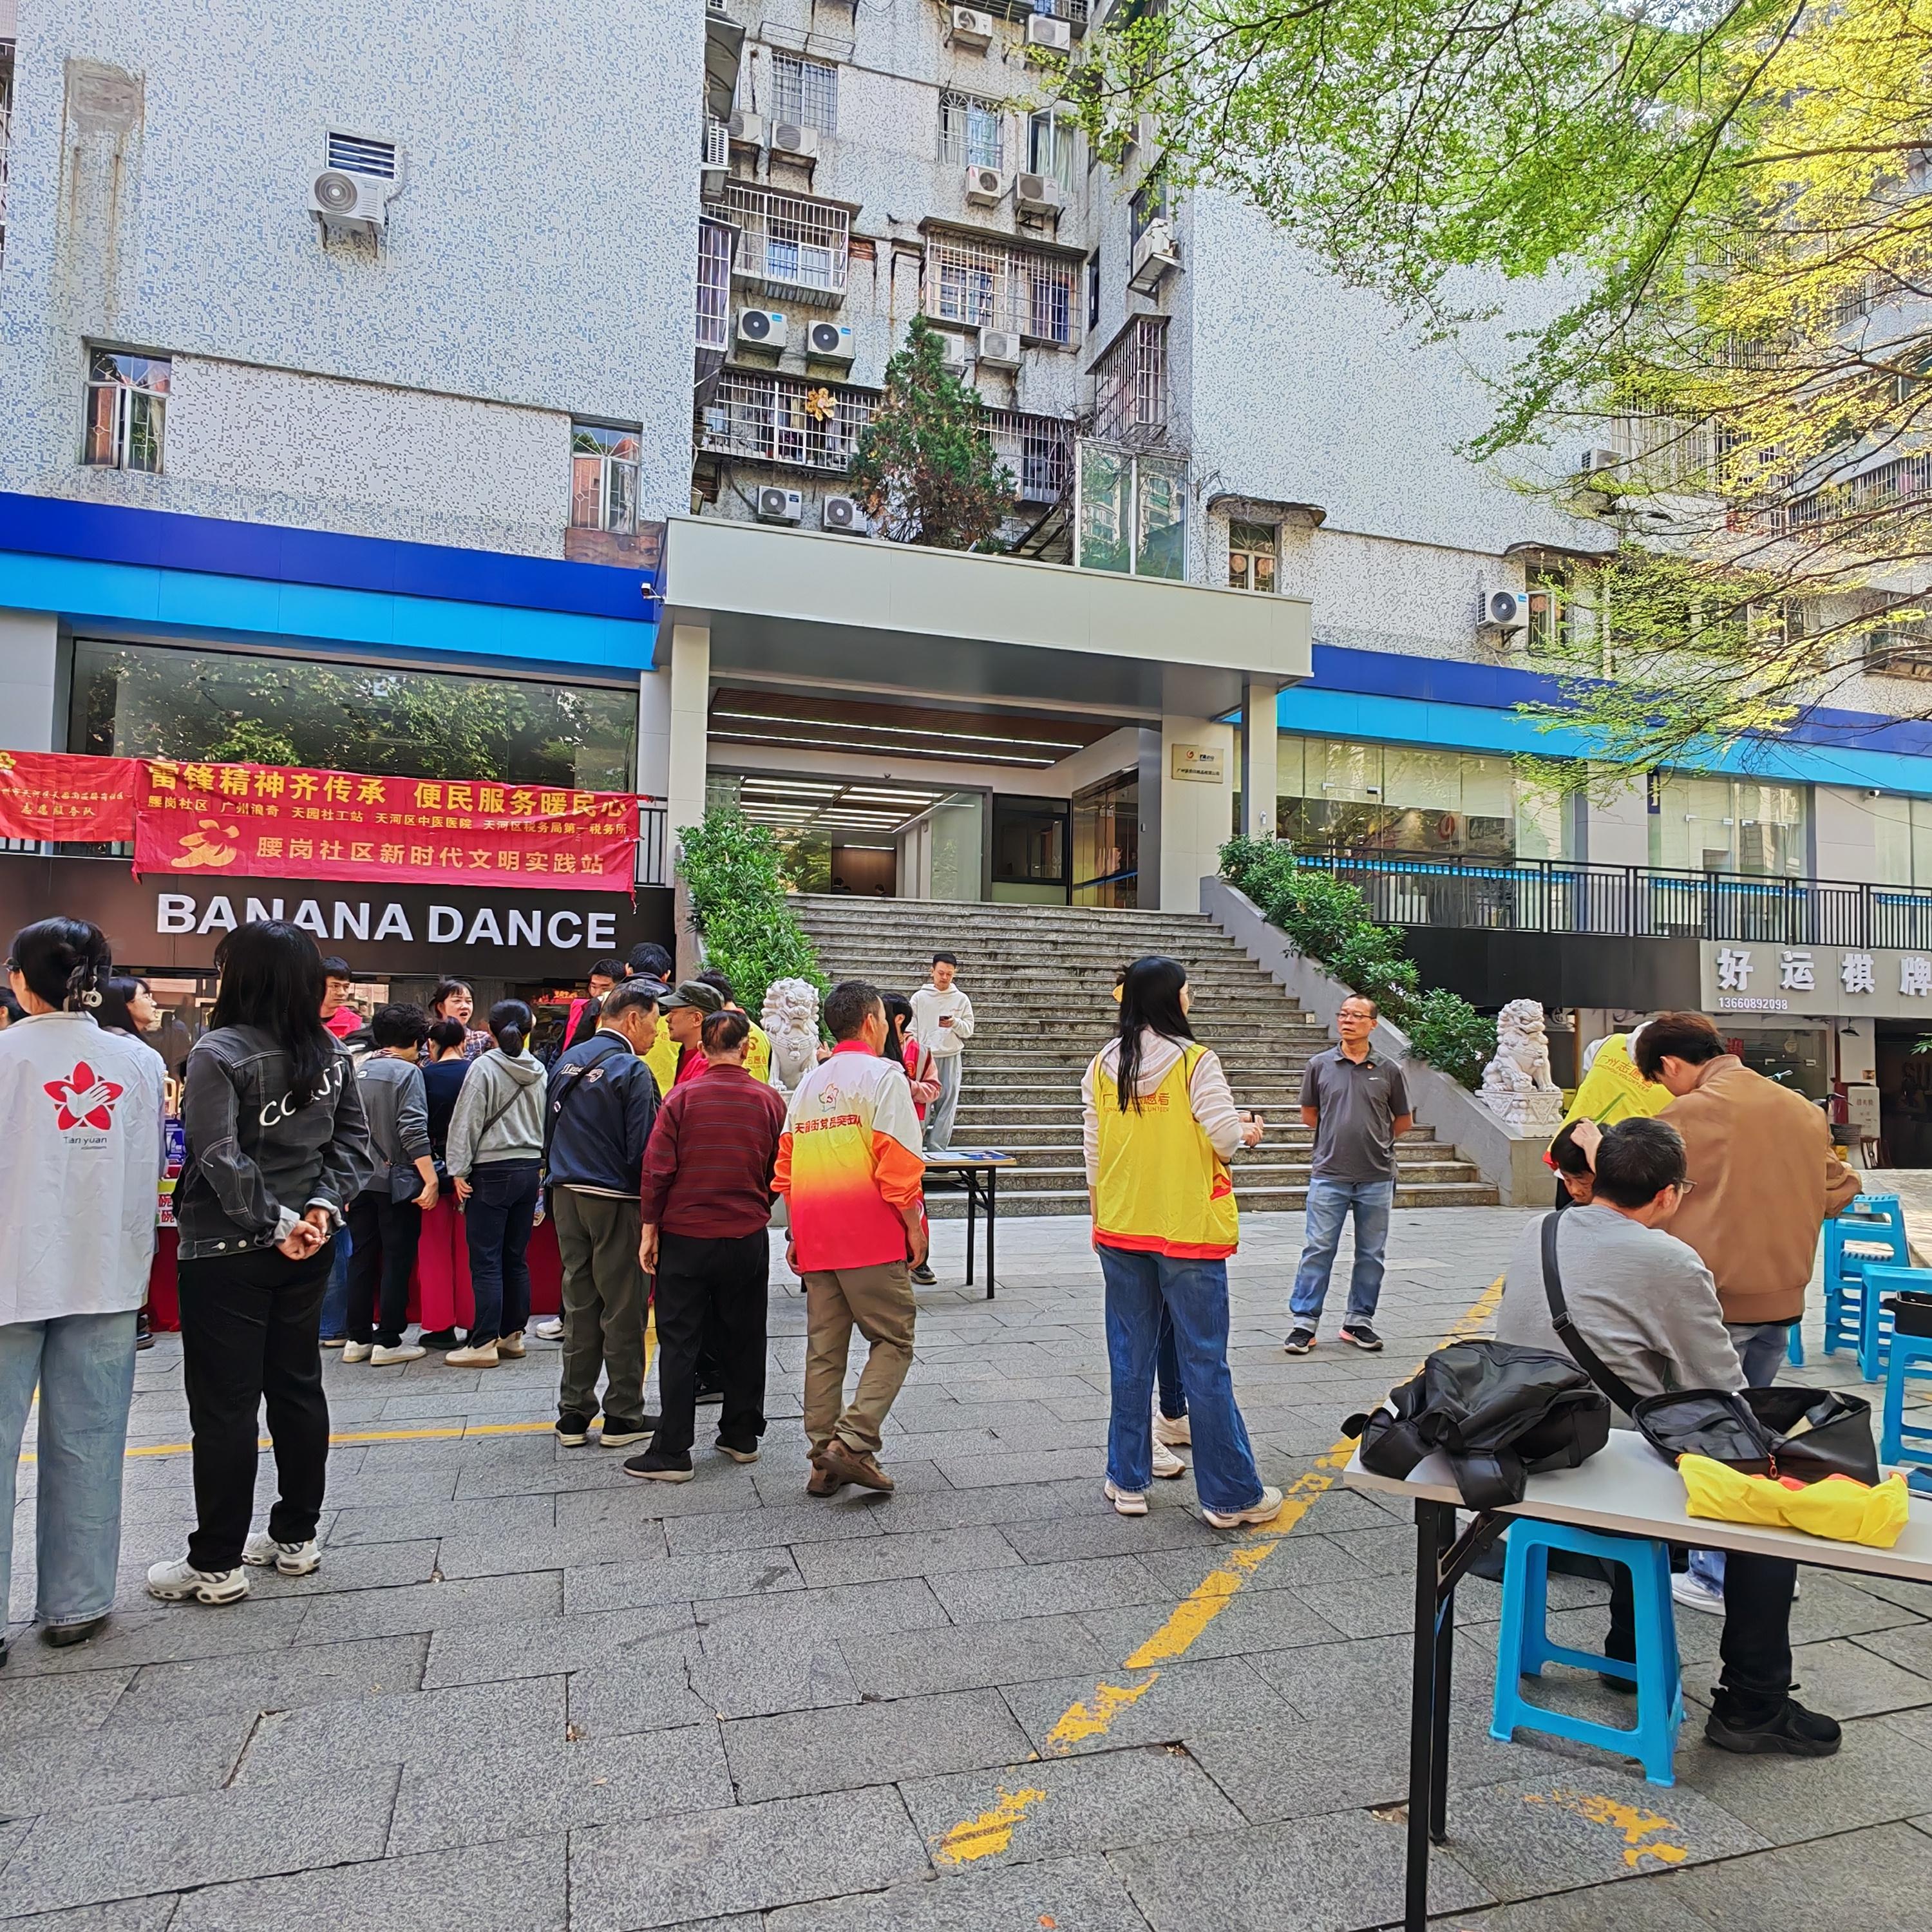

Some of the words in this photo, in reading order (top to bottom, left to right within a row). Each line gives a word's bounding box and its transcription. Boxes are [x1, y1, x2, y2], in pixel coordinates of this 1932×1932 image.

[148, 762, 386, 805] 雷锋精神齐传承
[413, 781, 627, 819] 便民服务暖民心
[147, 795, 209, 811] 腰岗社区
[220, 802, 279, 818] 广州浪奇
[291, 806, 364, 823] 天园社工站
[375, 813, 473, 829] 天河区中医医院
[482, 819, 627, 836] 天河区税务局第一税务所
[256, 836, 604, 876] 腰岗社区新时代文明实践站
[428, 904, 618, 950] DANCE
[1718, 947, 1932, 997] 好运棋牌
[1718, 997, 1788, 1010] 13660892098
